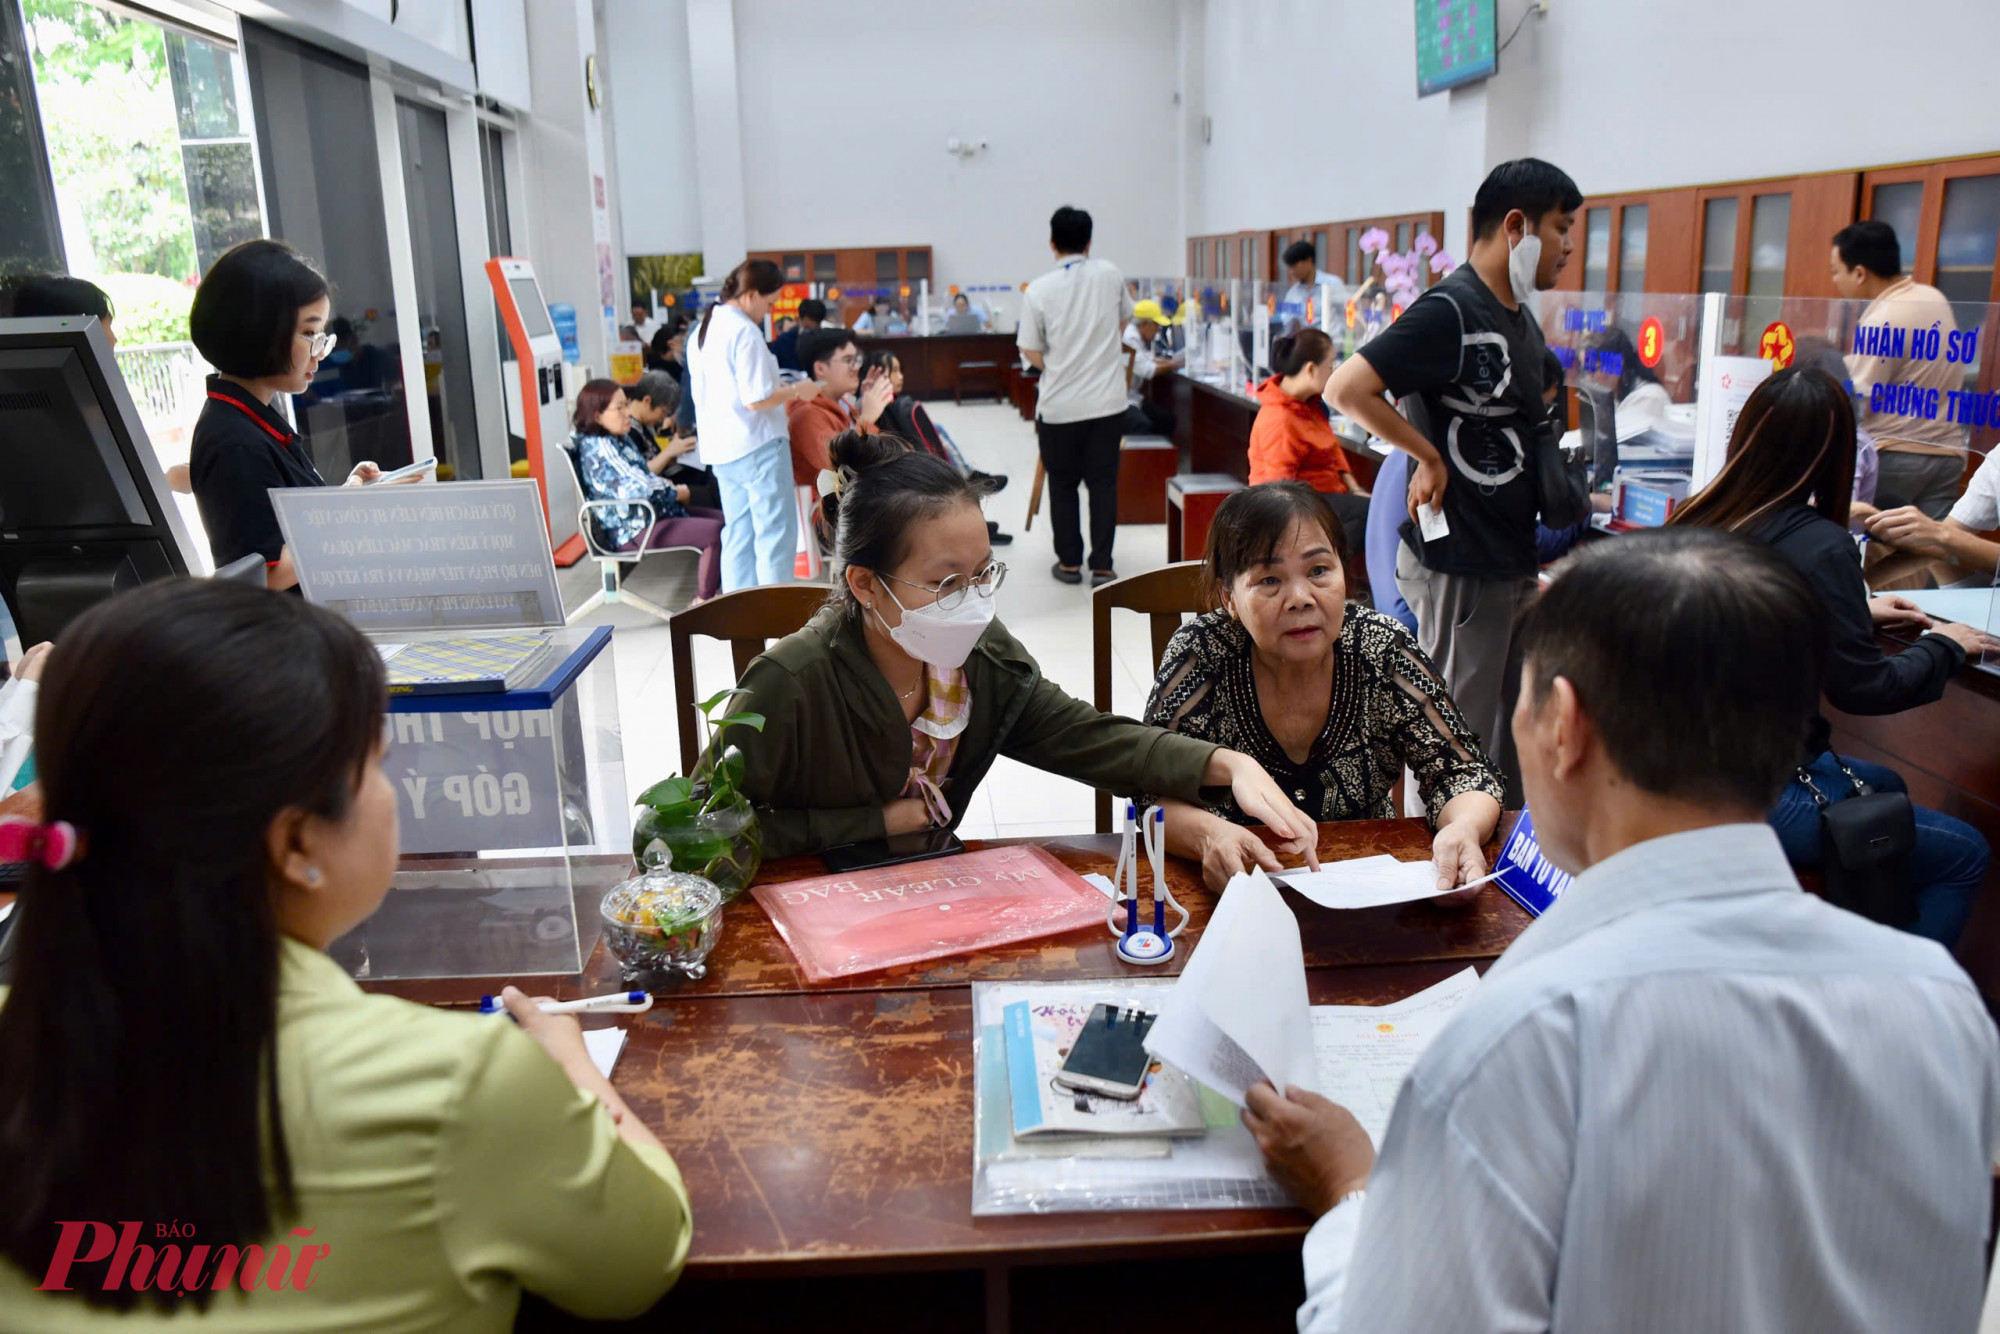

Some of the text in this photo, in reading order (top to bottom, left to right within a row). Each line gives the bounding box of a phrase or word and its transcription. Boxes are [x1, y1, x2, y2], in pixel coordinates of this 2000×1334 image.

[1644, 326, 1657, 358] 3
[1853, 320, 1979, 364] NHẬN HỒ SƠ
[1870, 381, 1940, 420] CHỨNG
[781, 880, 863, 905] BAG
[863, 876, 982, 903] CLEAR
